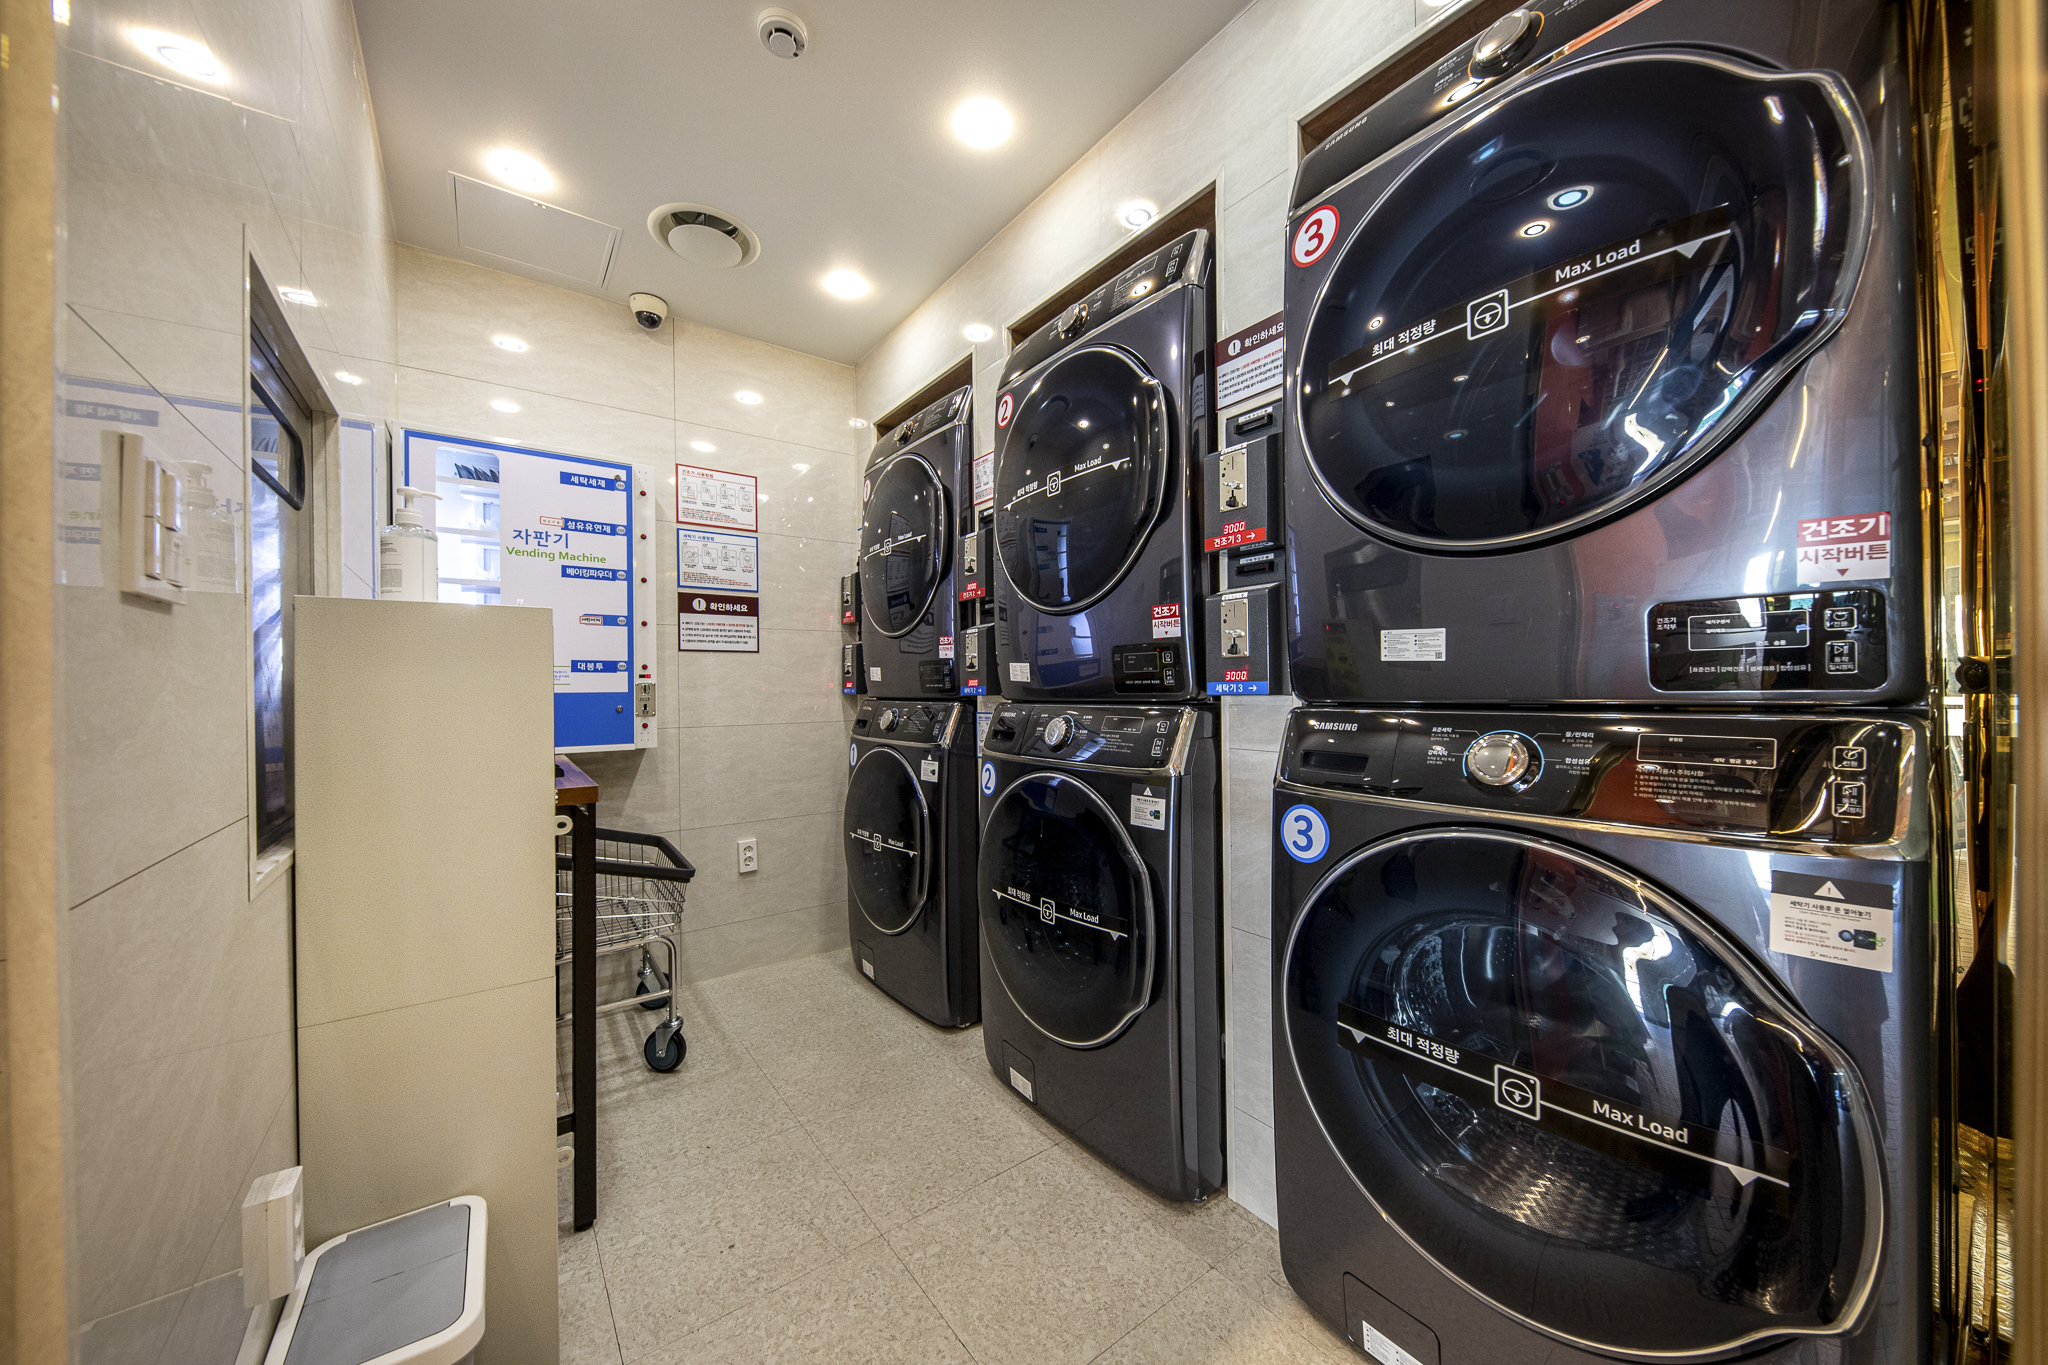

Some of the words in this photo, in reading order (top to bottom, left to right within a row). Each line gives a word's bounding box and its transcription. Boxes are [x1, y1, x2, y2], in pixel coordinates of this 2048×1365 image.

[1324, 116, 1368, 150] SAMSUNG
[1304, 218, 1324, 257] 3
[1554, 258, 1592, 283] Max
[1596, 239, 1641, 268] Load
[1244, 322, 1284, 348] 확인하세요
[1371, 336, 1395, 358] 최대
[1398, 318, 1437, 350] 적정량
[1000, 402, 1008, 422] 2
[1074, 462, 1086, 472] Max
[1087, 456, 1102, 468] Load
[571, 475, 606, 488] 세탁세제
[567, 521, 610, 533] 섬유유연제
[1224, 521, 1245, 534] 3000
[1802, 514, 1886, 542] 건조기
[512, 529, 568, 549] 자판기
[1214, 535, 1234, 547] 건조기
[1236, 534, 1241, 542] 3
[506, 546, 555, 561] Vending
[559, 551, 606, 563] Machine
[1800, 544, 1889, 564] 시작버튼
[566, 568, 612, 579] 베이킹파우더
[710, 602, 748, 612] 확인하세요
[1152, 605, 1179, 617] 건조기
[1153, 620, 1180, 629] 시작버튼
[578, 663, 603, 671] 대봉투
[1225, 671, 1247, 680] 3000
[1216, 684, 1236, 692] 세탁기
[1238, 684, 1243, 692] 3
[1314, 721, 1358, 731] SAMSUNG
[984, 768, 992, 790] 2
[1292, 814, 1314, 852] 3
[1070, 908, 1082, 919] Max
[1083, 911, 1099, 923] Load
[1843, 908, 1871, 918] 열어놓기
[1387, 1026, 1414, 1049] 최대
[1416, 1036, 1460, 1066] 적정량
[1592, 1100, 1634, 1127] Max
[1638, 1114, 1689, 1145] Load
